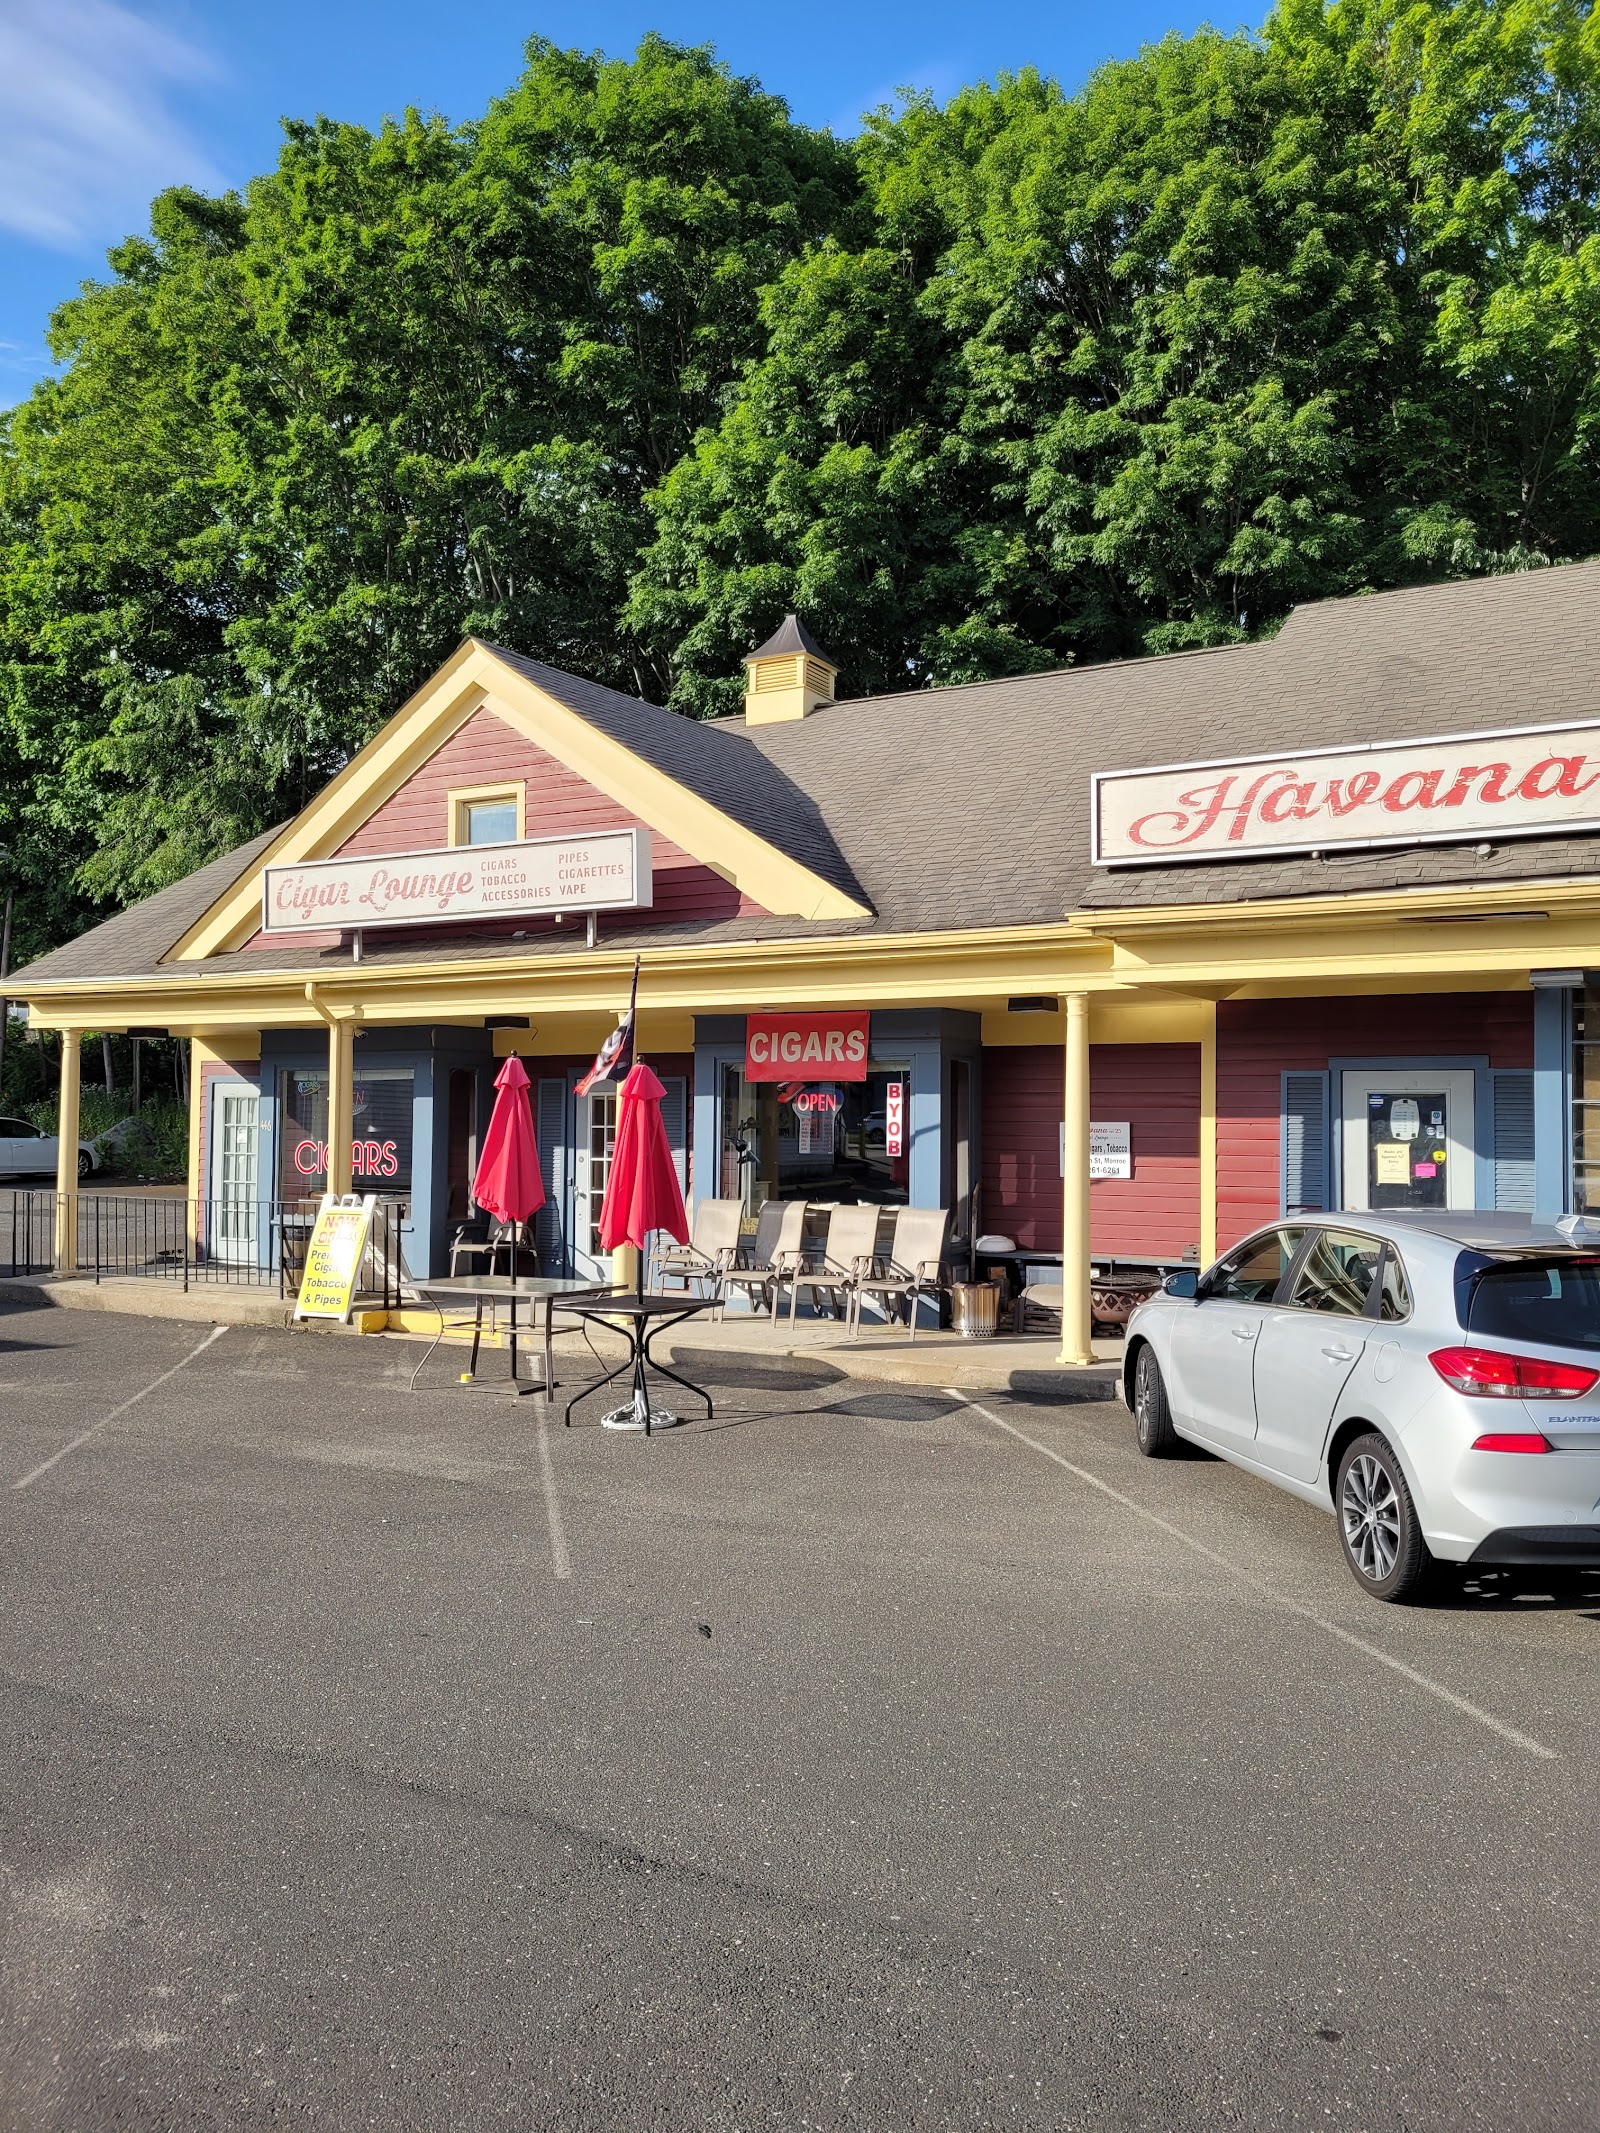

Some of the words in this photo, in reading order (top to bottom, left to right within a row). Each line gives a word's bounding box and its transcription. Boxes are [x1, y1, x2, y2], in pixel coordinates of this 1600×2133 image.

[1127, 753, 1600, 847] Havana
[481, 858, 518, 872] CIGARS
[558, 851, 589, 865] PIPES
[481, 873, 527, 887] TOBACCO
[558, 864, 624, 880] CIGARETTES
[276, 875, 350, 920] Cigar
[359, 869, 474, 912] Lounge
[481, 886, 551, 902] ACCESSORIES
[559, 883, 587, 896] VAPE
[750, 1030, 865, 1063] CIGARS
[797, 1093, 837, 1112] OPEN
[888, 1085, 901, 1155] BYOB
[1107, 1143, 1128, 1153] Tobacco
[295, 1140, 398, 1176] CIARS
[307, 1278, 347, 1288] Tobacco
[304, 1293, 311, 1303] &
[314, 1293, 342, 1306] Pipes
